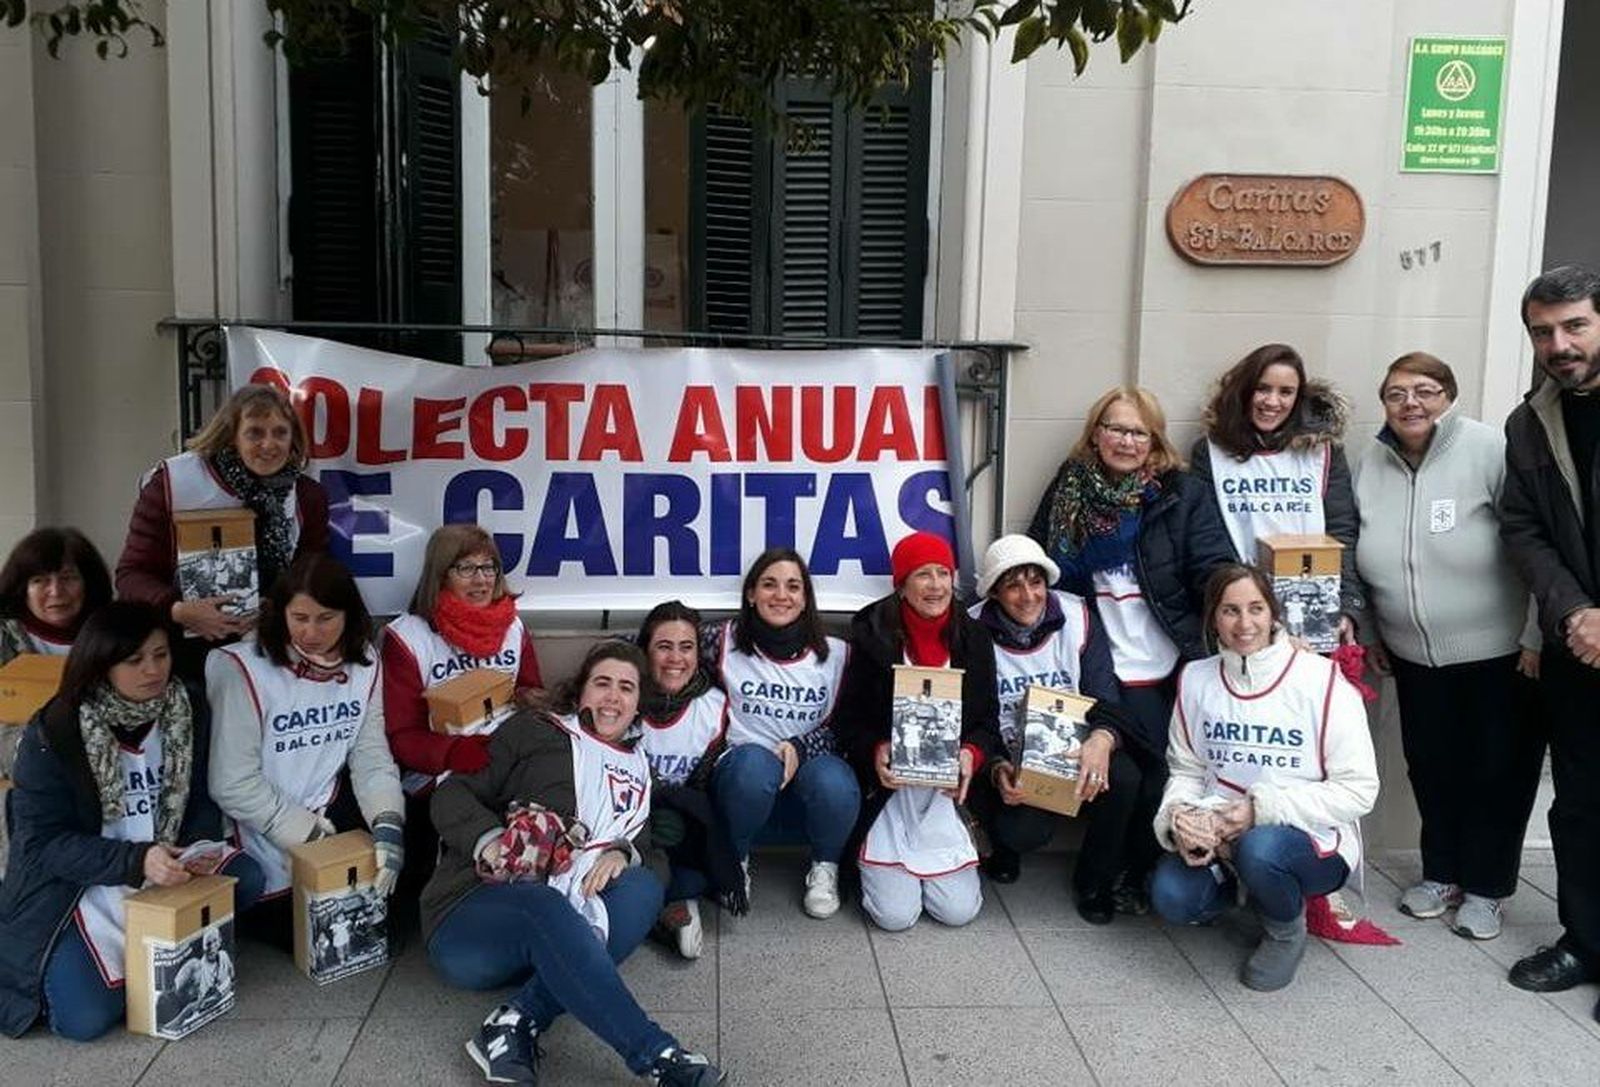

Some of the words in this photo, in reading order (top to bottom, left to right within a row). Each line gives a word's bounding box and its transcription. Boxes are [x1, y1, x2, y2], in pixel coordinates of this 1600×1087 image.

[1207, 181, 1332, 214] Caritas
[251, 366, 643, 465] OLECTA
[319, 469, 394, 577] E
[740, 681, 828, 703] CARITAS
[1000, 669, 1072, 696] ARTAS
[1202, 720, 1304, 747] CARITAS
